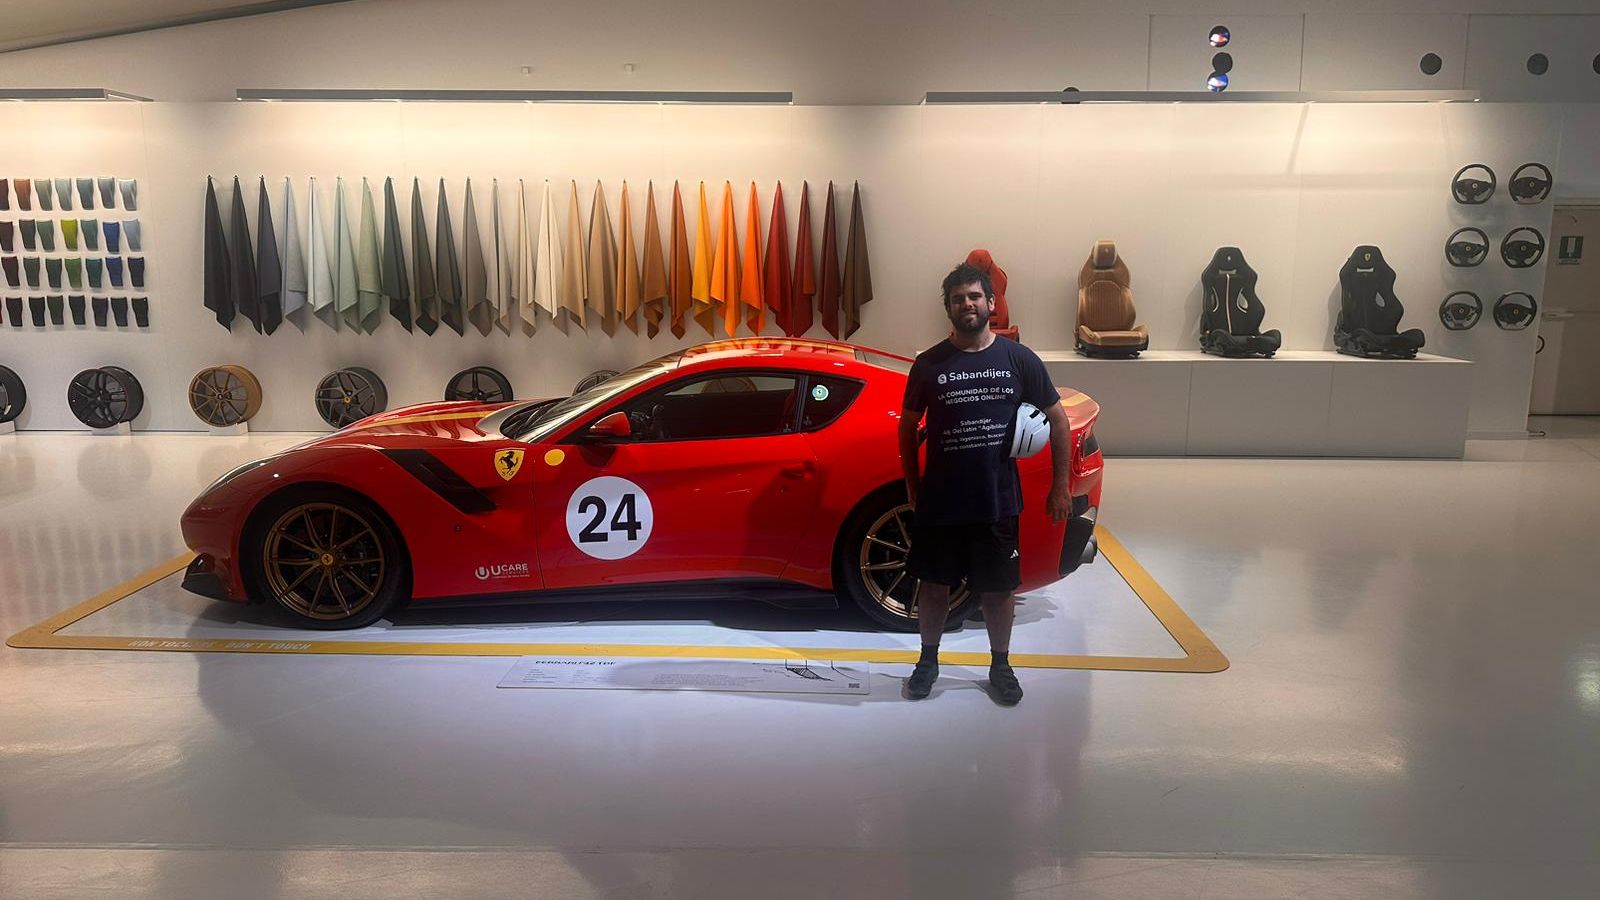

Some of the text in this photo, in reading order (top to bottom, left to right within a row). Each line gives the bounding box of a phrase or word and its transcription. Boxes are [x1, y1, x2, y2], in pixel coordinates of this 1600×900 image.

[949, 368, 1011, 381] Sabandijers
[946, 388, 988, 398] COMUNIDAD
[945, 396, 980, 405] NEGOCIOS
[578, 494, 641, 543] 24
[490, 563, 528, 576] UCARE
